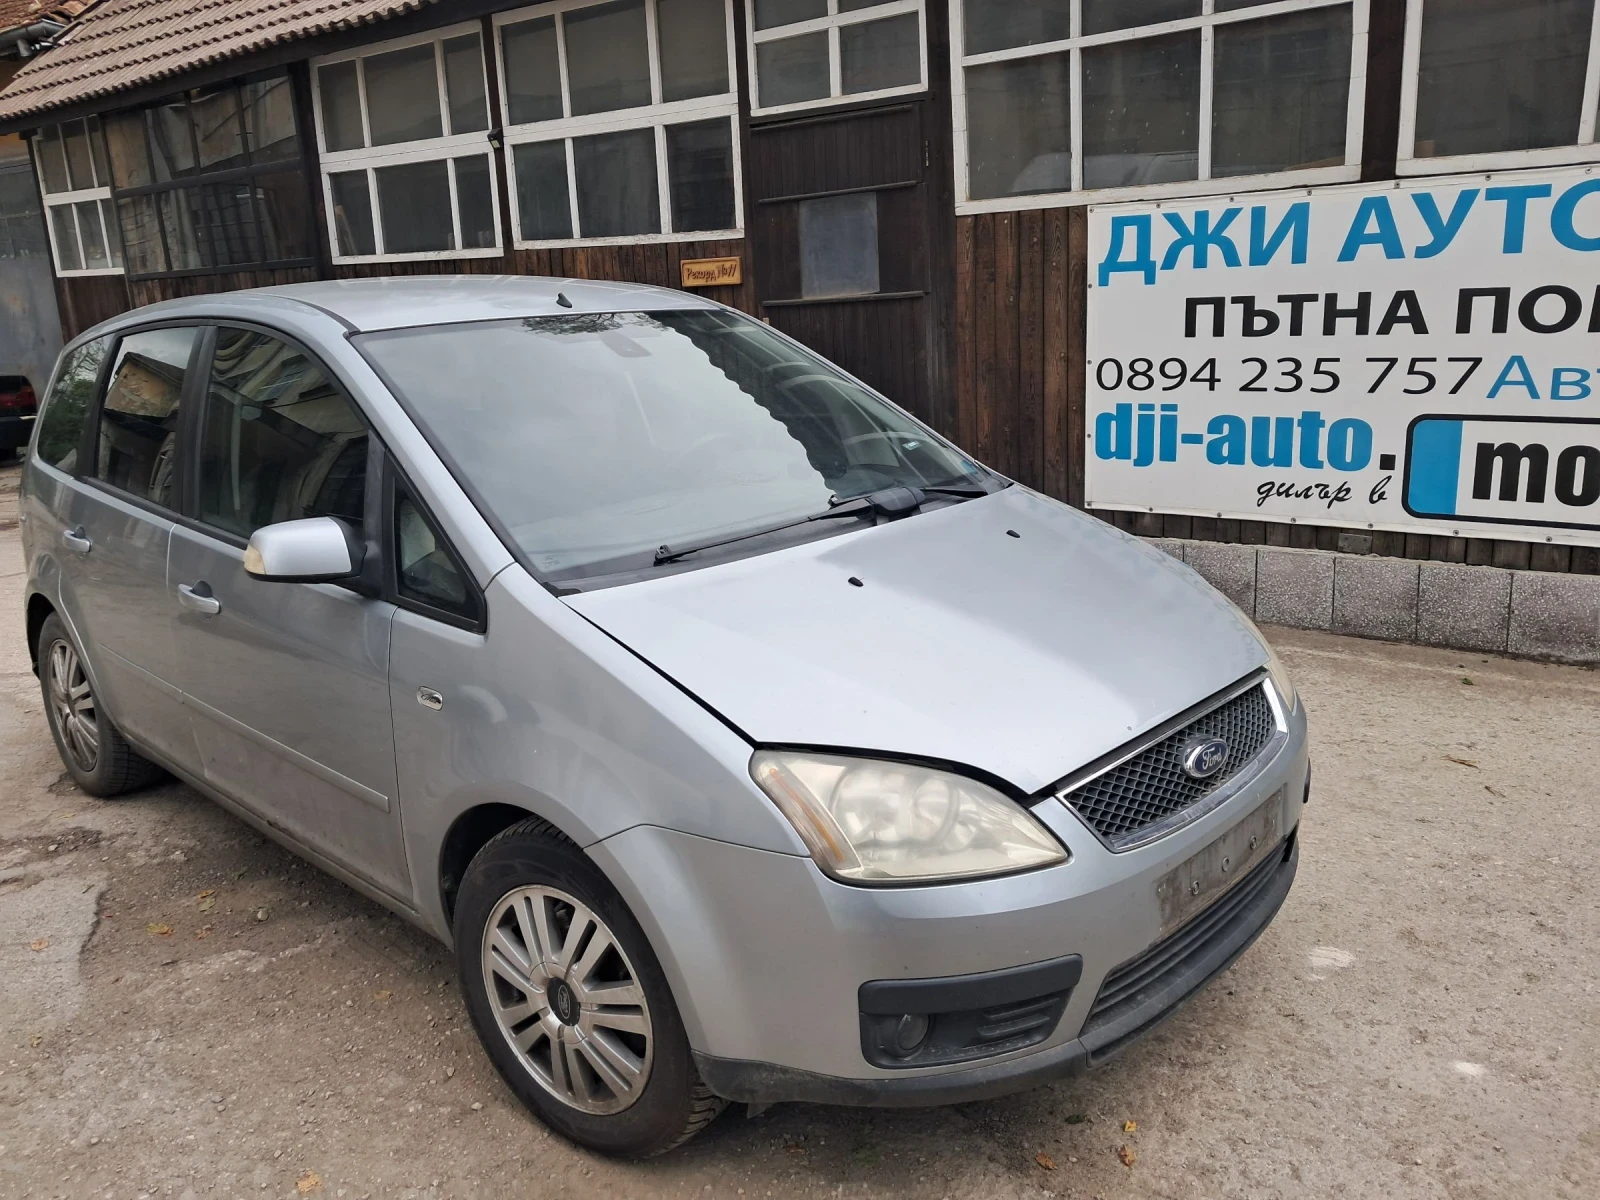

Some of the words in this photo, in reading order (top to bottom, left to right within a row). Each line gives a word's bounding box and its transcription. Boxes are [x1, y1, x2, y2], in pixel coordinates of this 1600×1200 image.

[1097, 201, 1311, 287] ДЖИ
[1184, 289, 1430, 338] ПЪТНА
[1455, 284, 1600, 334] ПО
[1095, 357, 1222, 392] 0894
[1238, 357, 1341, 394] 235
[1365, 357, 1483, 395] 757
[1485, 355, 1600, 401] Ав
[1256, 480, 1352, 509] дилър
[1368, 474, 1393, 504] в
[1472, 441, 1600, 507] mo
[1202, 746, 1222, 770] Ford
